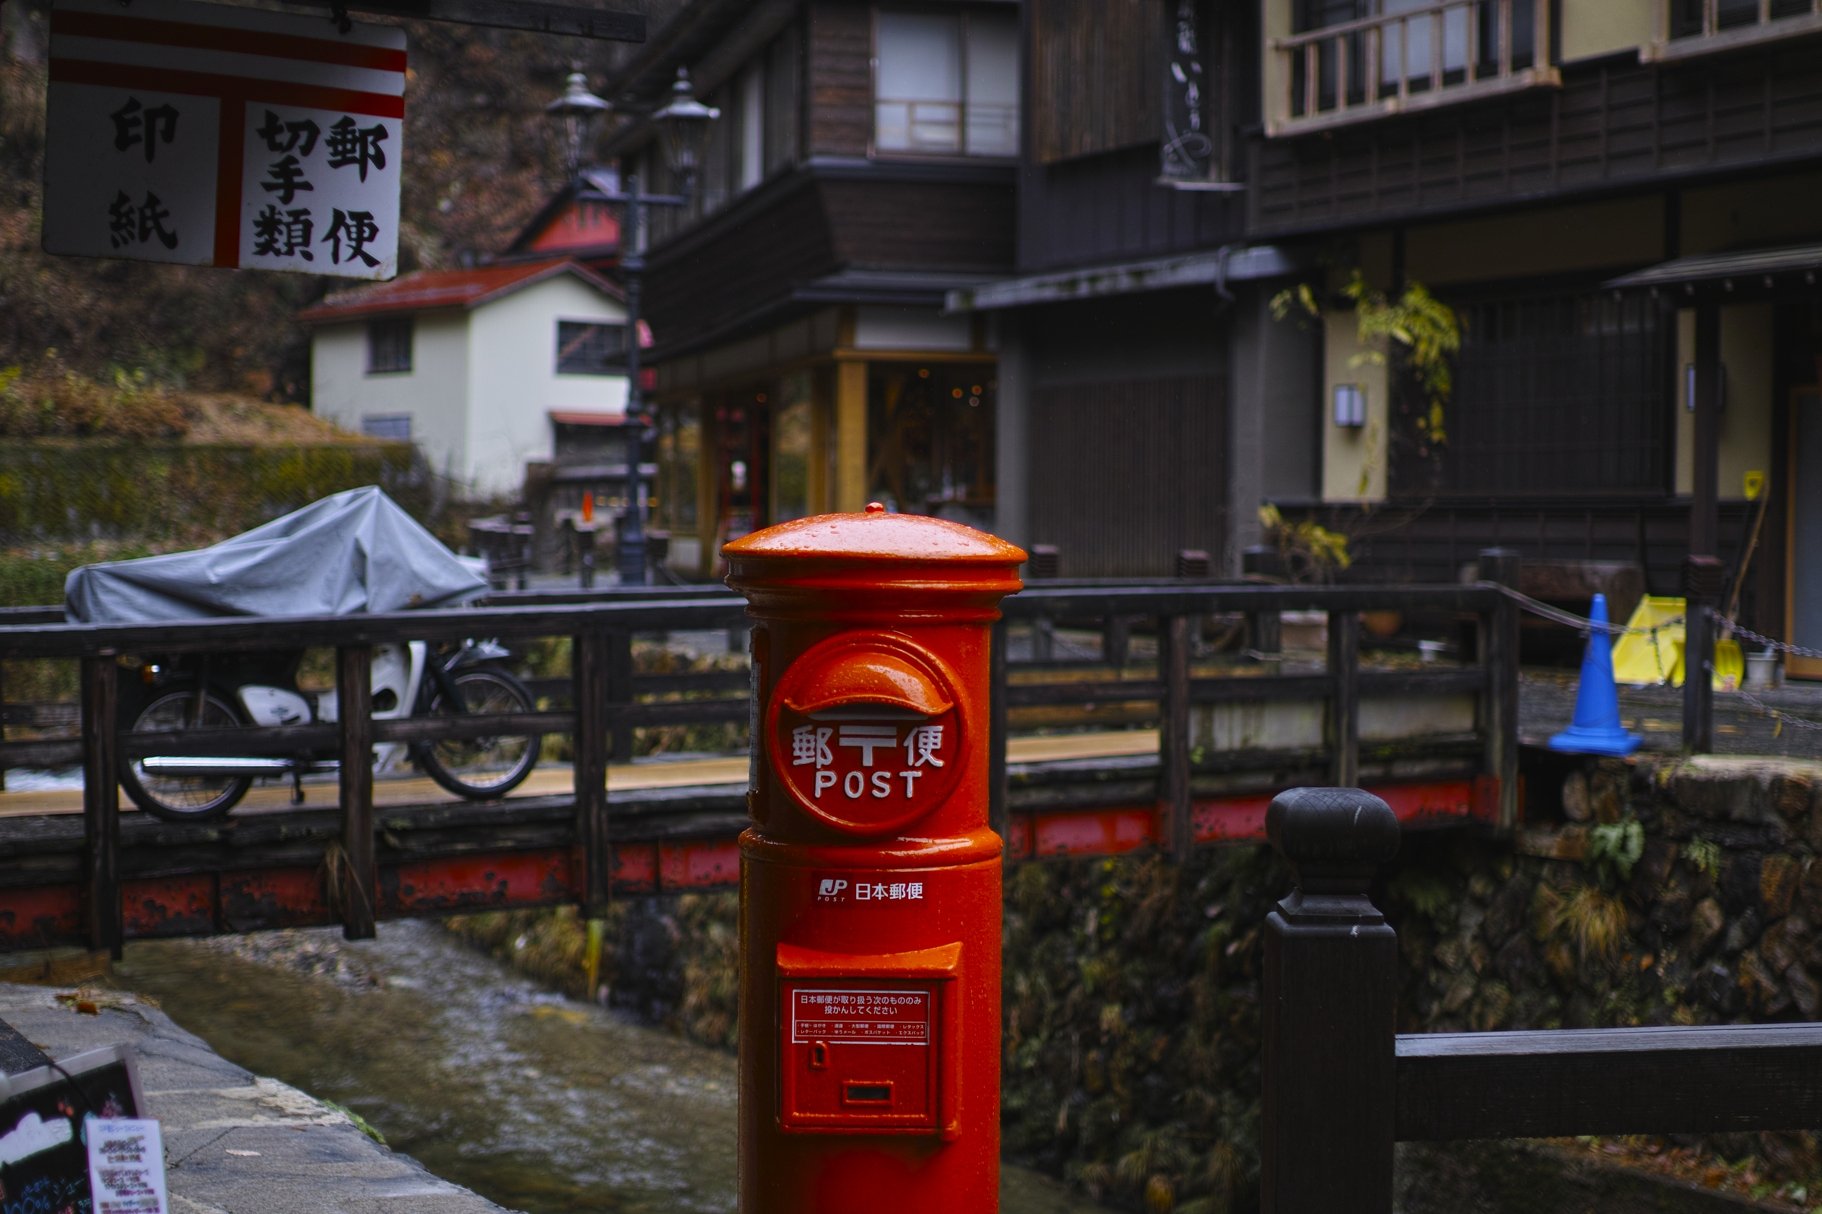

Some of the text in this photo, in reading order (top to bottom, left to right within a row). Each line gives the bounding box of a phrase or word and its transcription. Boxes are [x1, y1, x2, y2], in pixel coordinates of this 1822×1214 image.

[109, 96, 179, 250] 印紙
[252, 109, 321, 262] 切手類
[321, 115, 389, 268] 郵便
[814, 771, 922, 799] POST
[855, 882, 923, 900] 日本郵便
[800, 995, 922, 1005] 日本郵便が取り扱う次のもののみ
[824, 1005, 898, 1015] 投かんしてください
